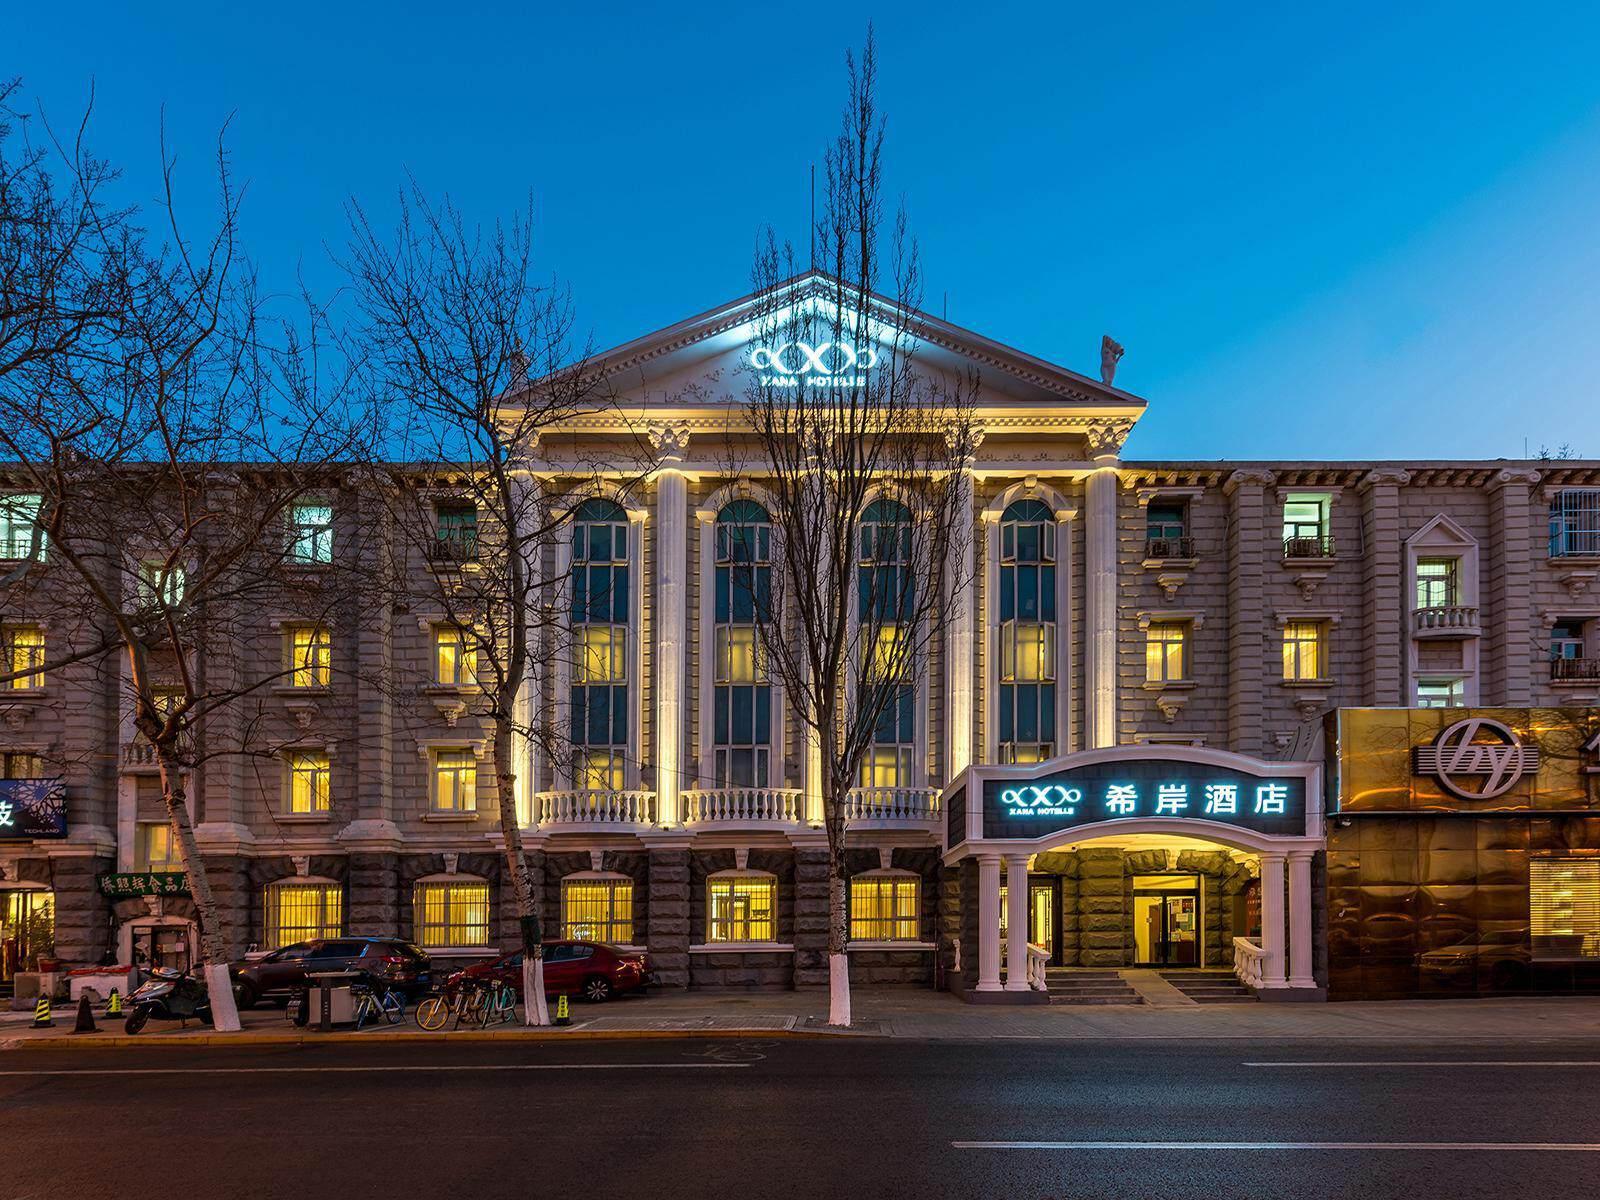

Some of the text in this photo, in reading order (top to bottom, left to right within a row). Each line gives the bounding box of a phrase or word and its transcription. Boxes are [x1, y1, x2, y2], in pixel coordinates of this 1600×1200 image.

[1105, 784, 1288, 815] 希岸酒店
[1009, 807, 1074, 816] XANA HOTELLE
